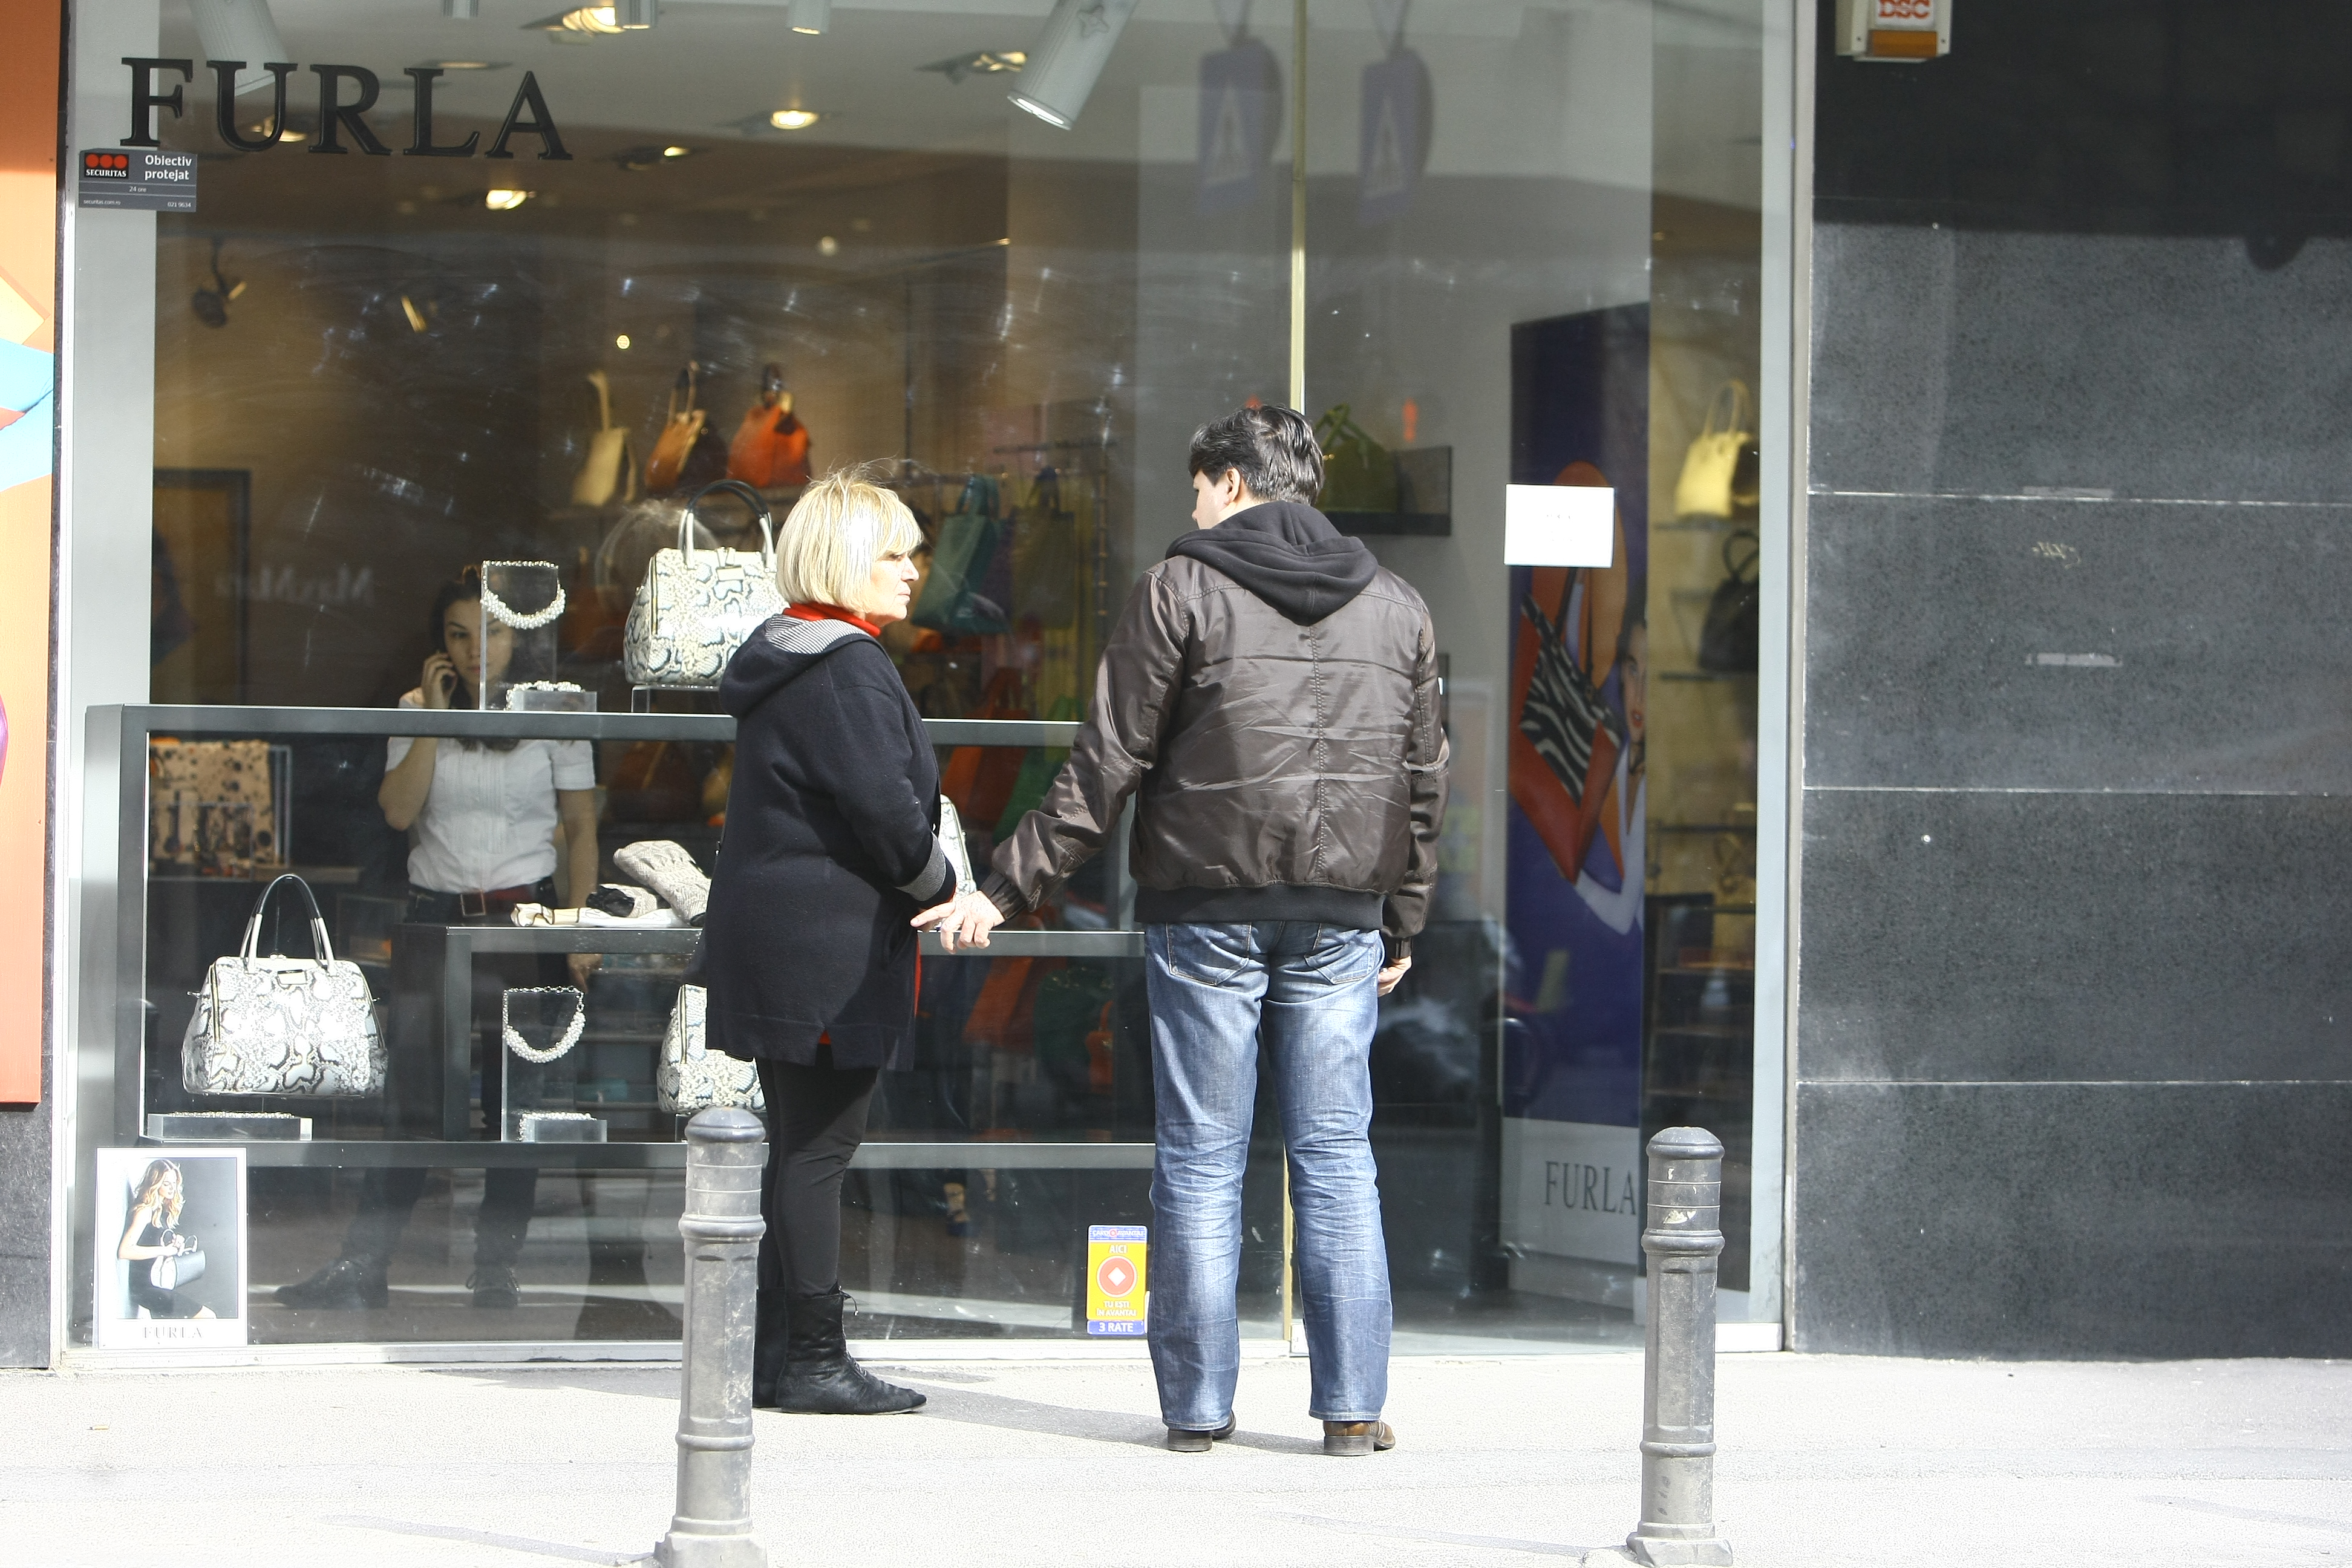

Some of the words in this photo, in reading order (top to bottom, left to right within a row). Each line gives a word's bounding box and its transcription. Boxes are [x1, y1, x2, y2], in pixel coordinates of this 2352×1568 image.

[120, 57, 573, 160] FURLA
[145, 155, 192, 166] Obiectiv
[86, 169, 126, 177] SECURITAS
[145, 169, 189, 181] protejat
[1544, 1160, 1636, 1215] FURLA
[1109, 1244, 1128, 1253] AICI
[1099, 1322, 1106, 1332] 3
[1108, 1322, 1134, 1333] RATE
